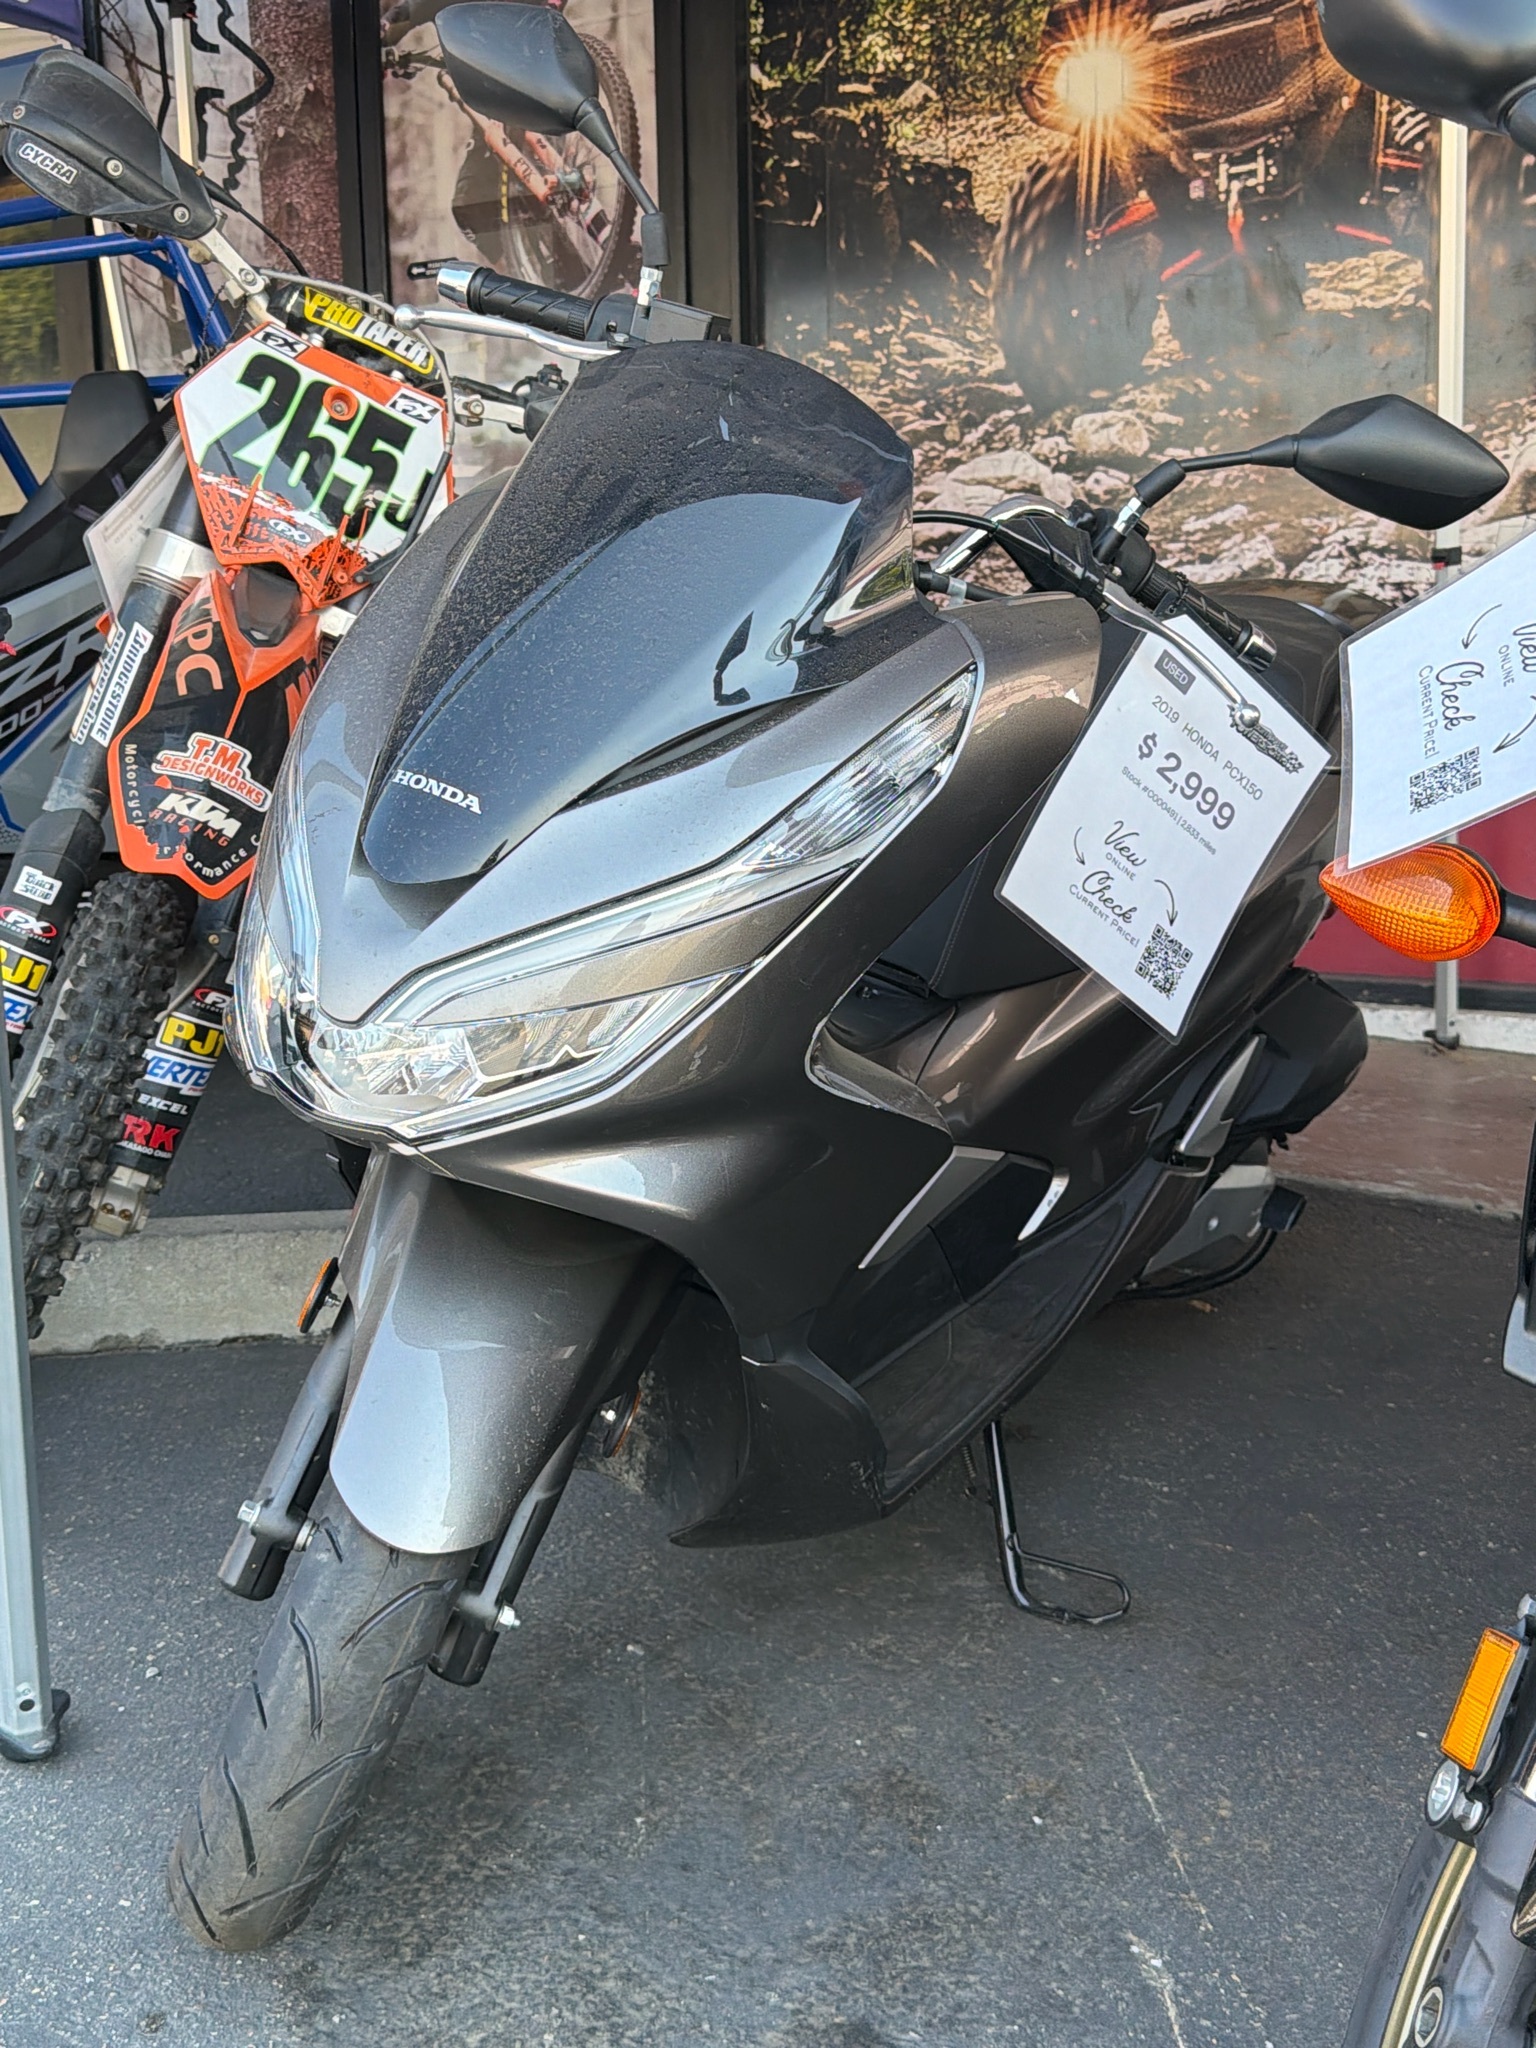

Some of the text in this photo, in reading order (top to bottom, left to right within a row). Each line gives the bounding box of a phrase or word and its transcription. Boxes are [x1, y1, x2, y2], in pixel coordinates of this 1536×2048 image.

[21, 144, 76, 182] CYCRA
[96, 628, 148, 742] BRIDGESTONE
[1162, 657, 1190, 686] USED
[1498, 644, 1515, 688] ONLINE
[1435, 661, 1485, 731] Check
[189, 737, 243, 778] T.M.
[1151, 695, 1181, 724] 2019
[1182, 721, 1220, 763] HONDA
[1222, 759, 1264, 801] PCX150
[159, 754, 266, 806] DESIGNWORKS
[392, 769, 483, 815] HONDA
[1121, 766, 1142, 788] Stock
[148, 807, 231, 848] RACING
[156, 791, 243, 840] KTM
[1104, 820, 1147, 867] View
[1105, 852, 1137, 881] ONLINE
[1082, 870, 1138, 923] Check
[137, 1093, 189, 1116] EXCEL
[123, 1113, 181, 1152] RK
